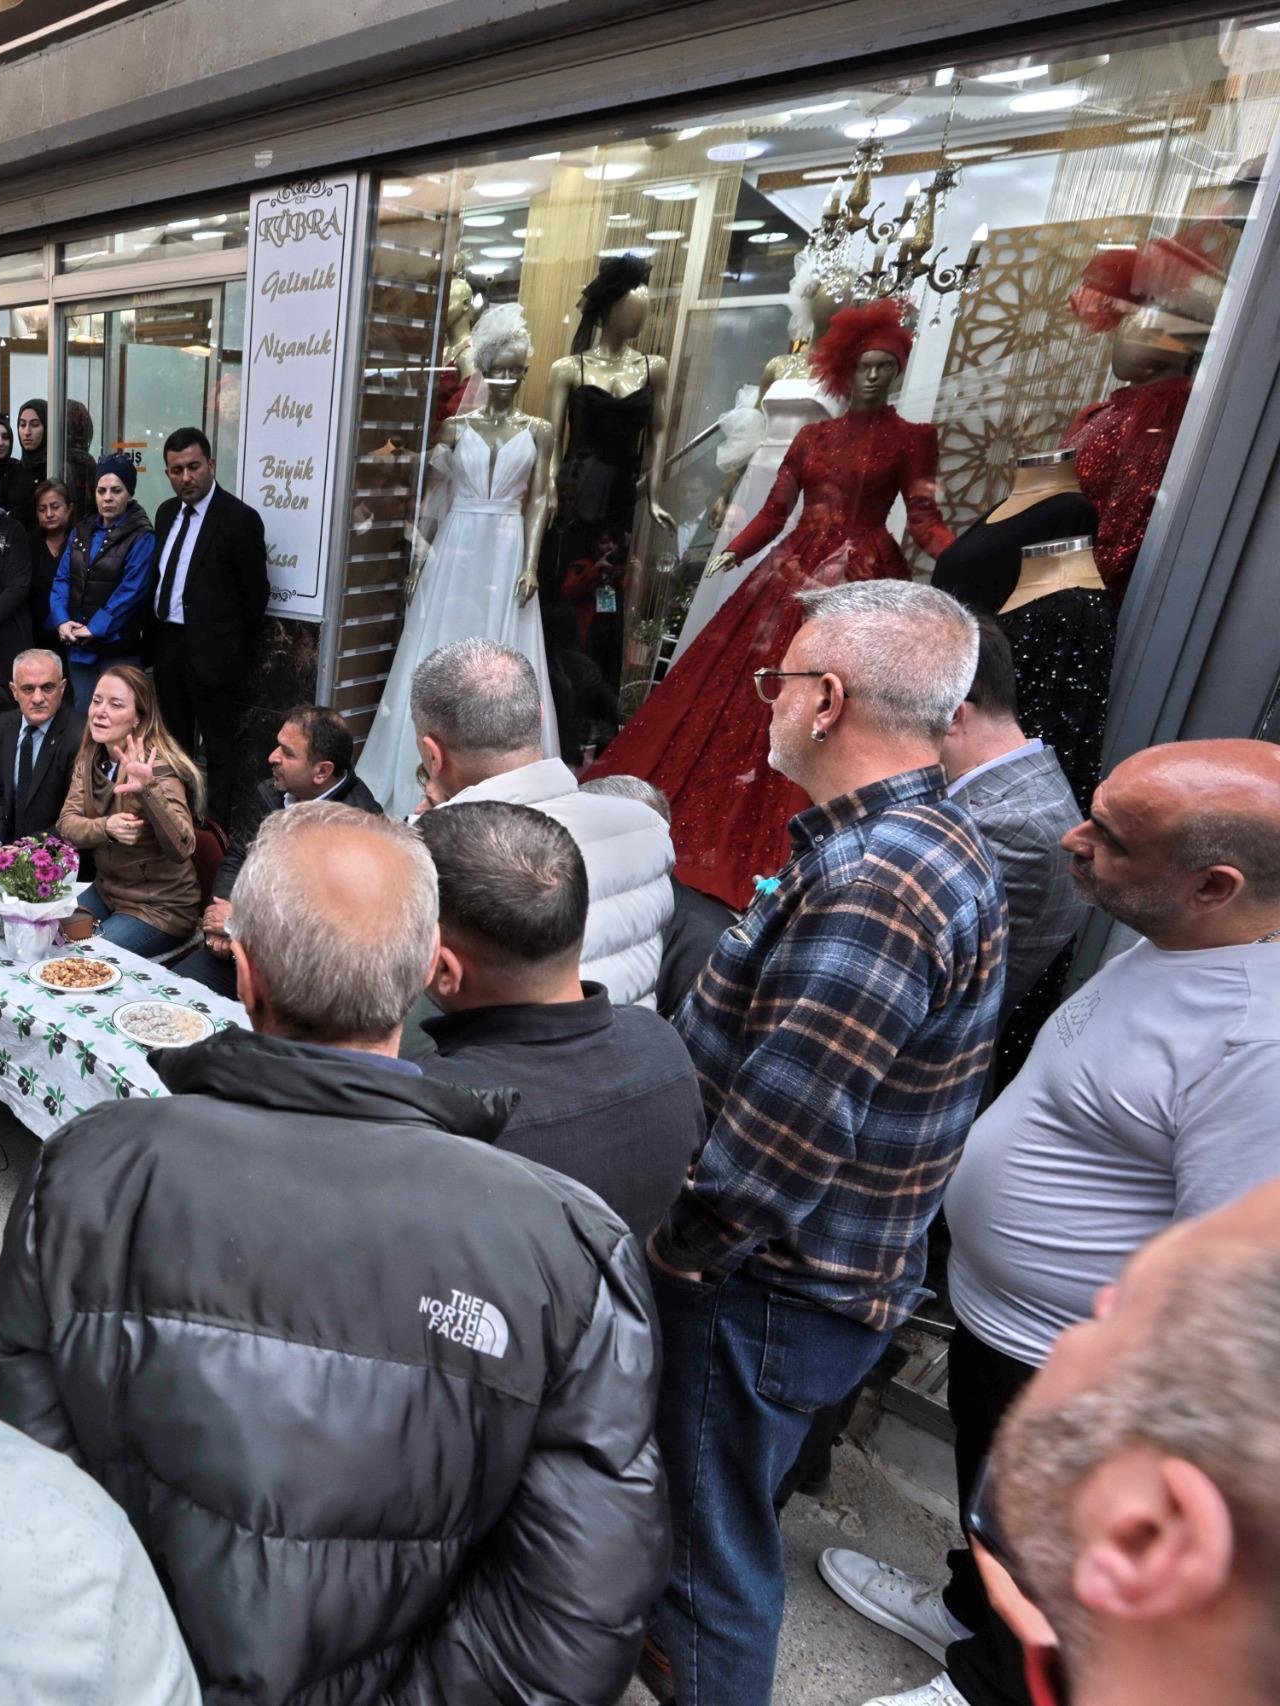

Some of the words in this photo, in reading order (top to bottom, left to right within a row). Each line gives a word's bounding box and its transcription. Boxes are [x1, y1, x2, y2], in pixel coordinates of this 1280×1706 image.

[258, 206, 343, 248] KÜBRA
[261, 262, 336, 303] Gelinlik
[259, 455, 314, 488] Büyük
[259, 484, 309, 510] Beden
[418, 1296, 479, 1334] NORTH
[451, 1288, 483, 1316] THE
[428, 1315, 476, 1348] FACE
